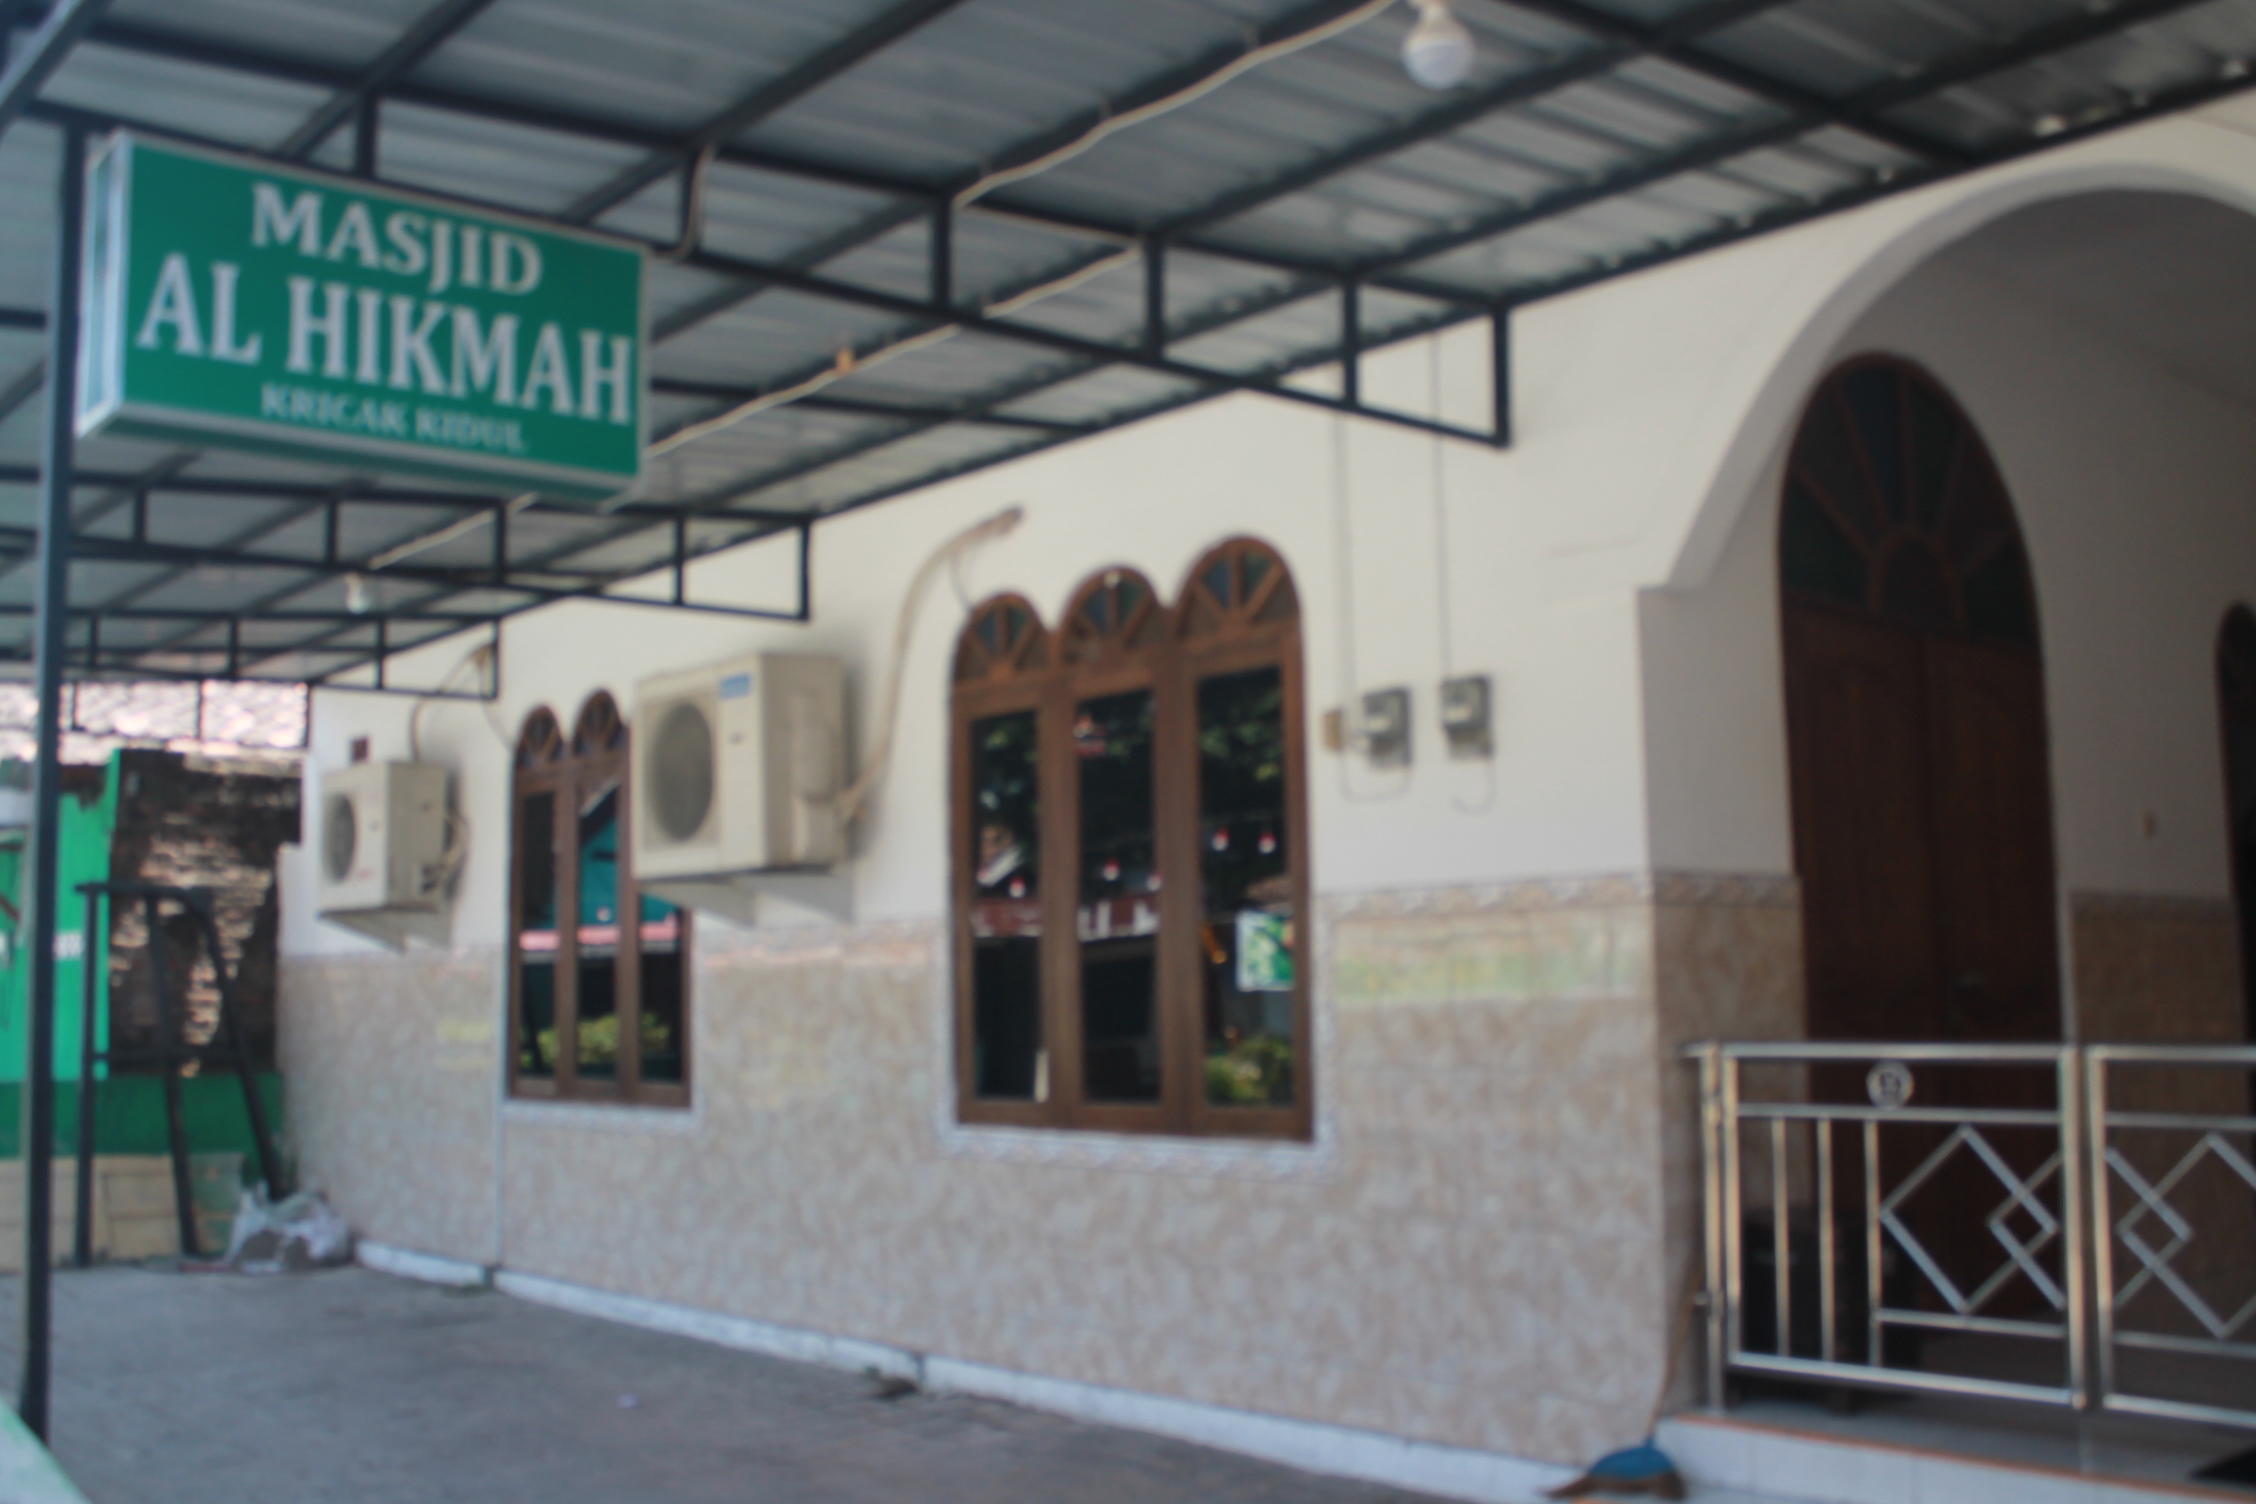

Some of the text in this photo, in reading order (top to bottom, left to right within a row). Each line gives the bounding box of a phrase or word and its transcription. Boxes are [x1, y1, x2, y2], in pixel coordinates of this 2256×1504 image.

[252, 182, 543, 294] MASJID
[137, 252, 632, 424] AL HIKMAH
[260, 382, 527, 453] KRICAK KIDUL
